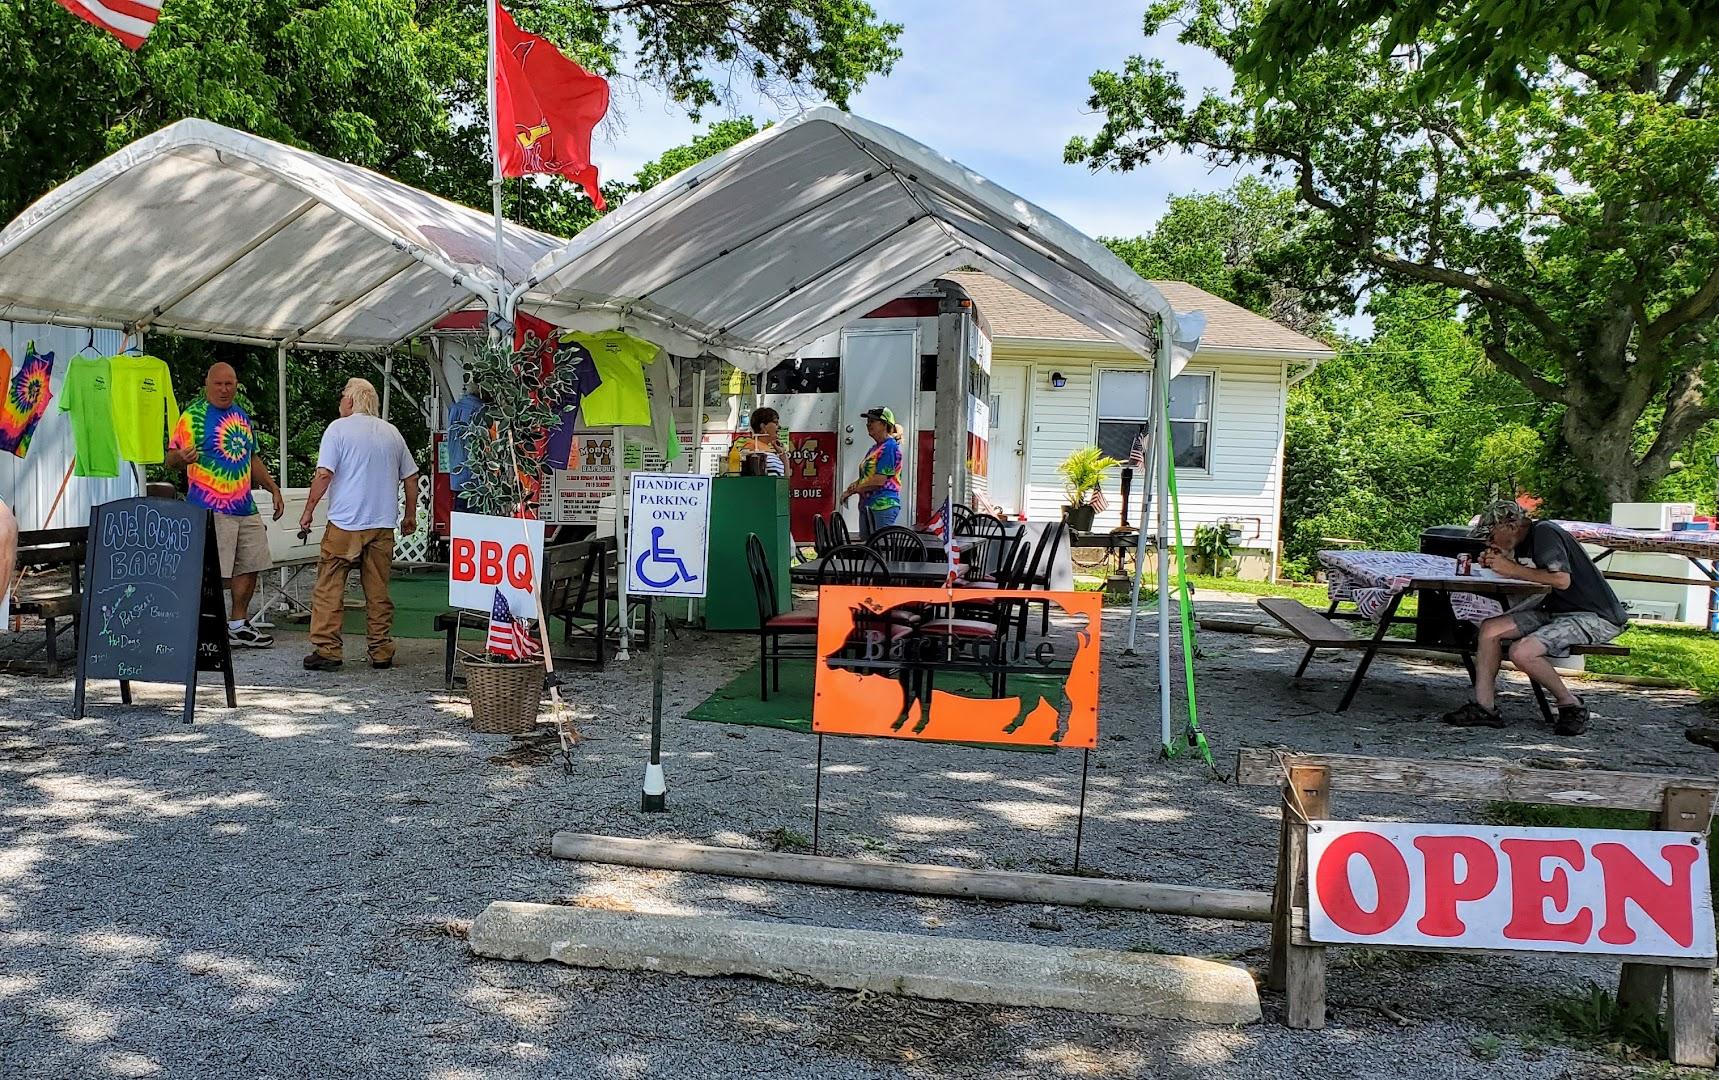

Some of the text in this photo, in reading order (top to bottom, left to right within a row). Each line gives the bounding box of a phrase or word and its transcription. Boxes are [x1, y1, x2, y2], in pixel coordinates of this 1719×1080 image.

[636, 479, 704, 491] HANDICAP
[640, 494, 698, 506] PARKING
[652, 509, 687, 521] ONLY
[110, 550, 181, 580] BACK!
[452, 537, 534, 594] BBQ
[1316, 831, 1699, 948] OPEN
